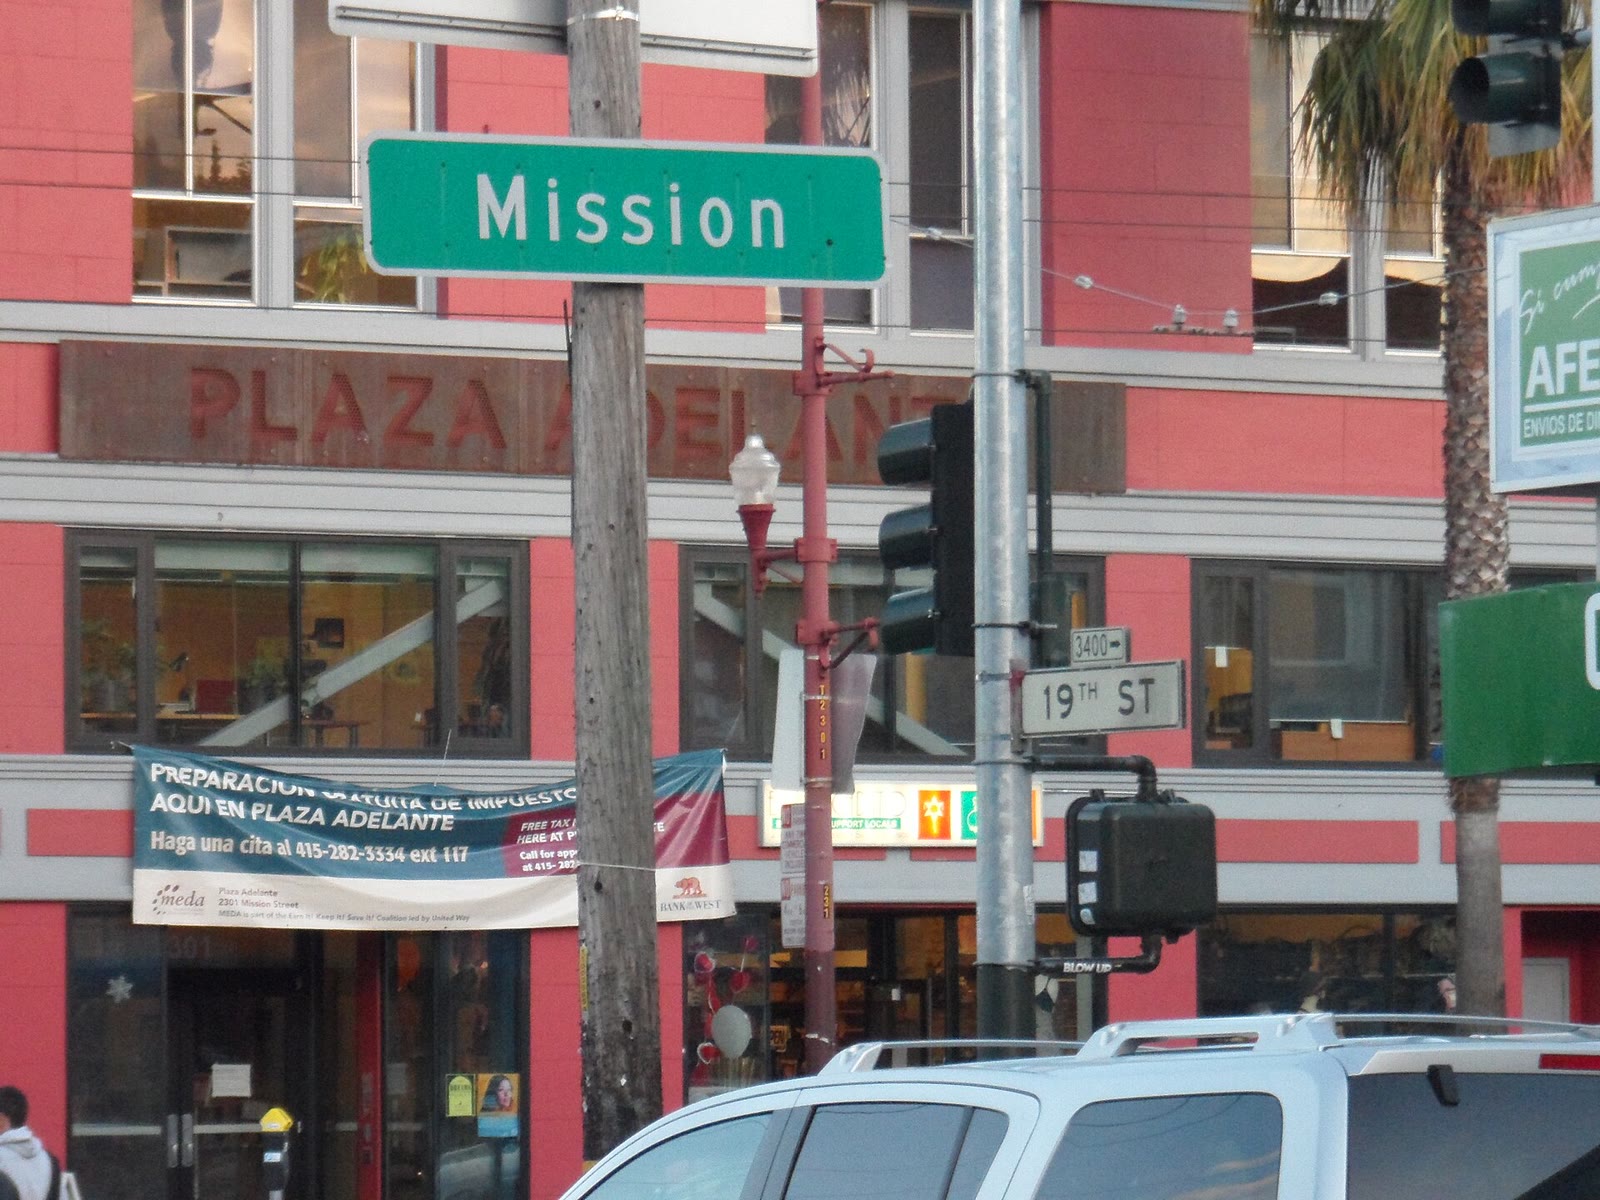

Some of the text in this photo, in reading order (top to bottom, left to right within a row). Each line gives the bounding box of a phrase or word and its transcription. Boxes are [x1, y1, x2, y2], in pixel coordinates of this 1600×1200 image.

[476, 172, 785, 249] Mission
[189, 366, 507, 450] PLAZA
[1523, 415, 1566, 438] ENVIOS
[1568, 412, 1584, 434] DE
[1074, 634, 1108, 658] 3400
[1043, 678, 1156, 720] 19TH ST
[150, 793, 454, 831] AQUI EN PLAZA ADELANTE
[521, 821, 548, 831] FREE
[550, 819, 571, 829] TAX
[865, 818, 898, 829] LOCALS
[516, 833, 547, 844] HERE
[550, 831, 564, 842] AT
[151, 831, 469, 863] Haga una cita al 415-282-3334 ext 117
[520, 850, 538, 860] Call
[540, 850, 555, 859] for
[522, 863, 533, 872] at
[160, 890, 206, 907] meda
[218, 887, 278, 897] Plaza Adelante
[218, 898, 299, 909] 2301 Mission Street
[660, 901, 686, 912] BANK
[694, 900, 721, 910] WEST
[218, 910, 241, 918] MEDA
[376, 914, 408, 922] Coalition
[421, 915, 430, 923] by
[432, 914, 454, 922] United
[456, 914, 470, 923] Way
[1062, 962, 1112, 973] BLOW UP
